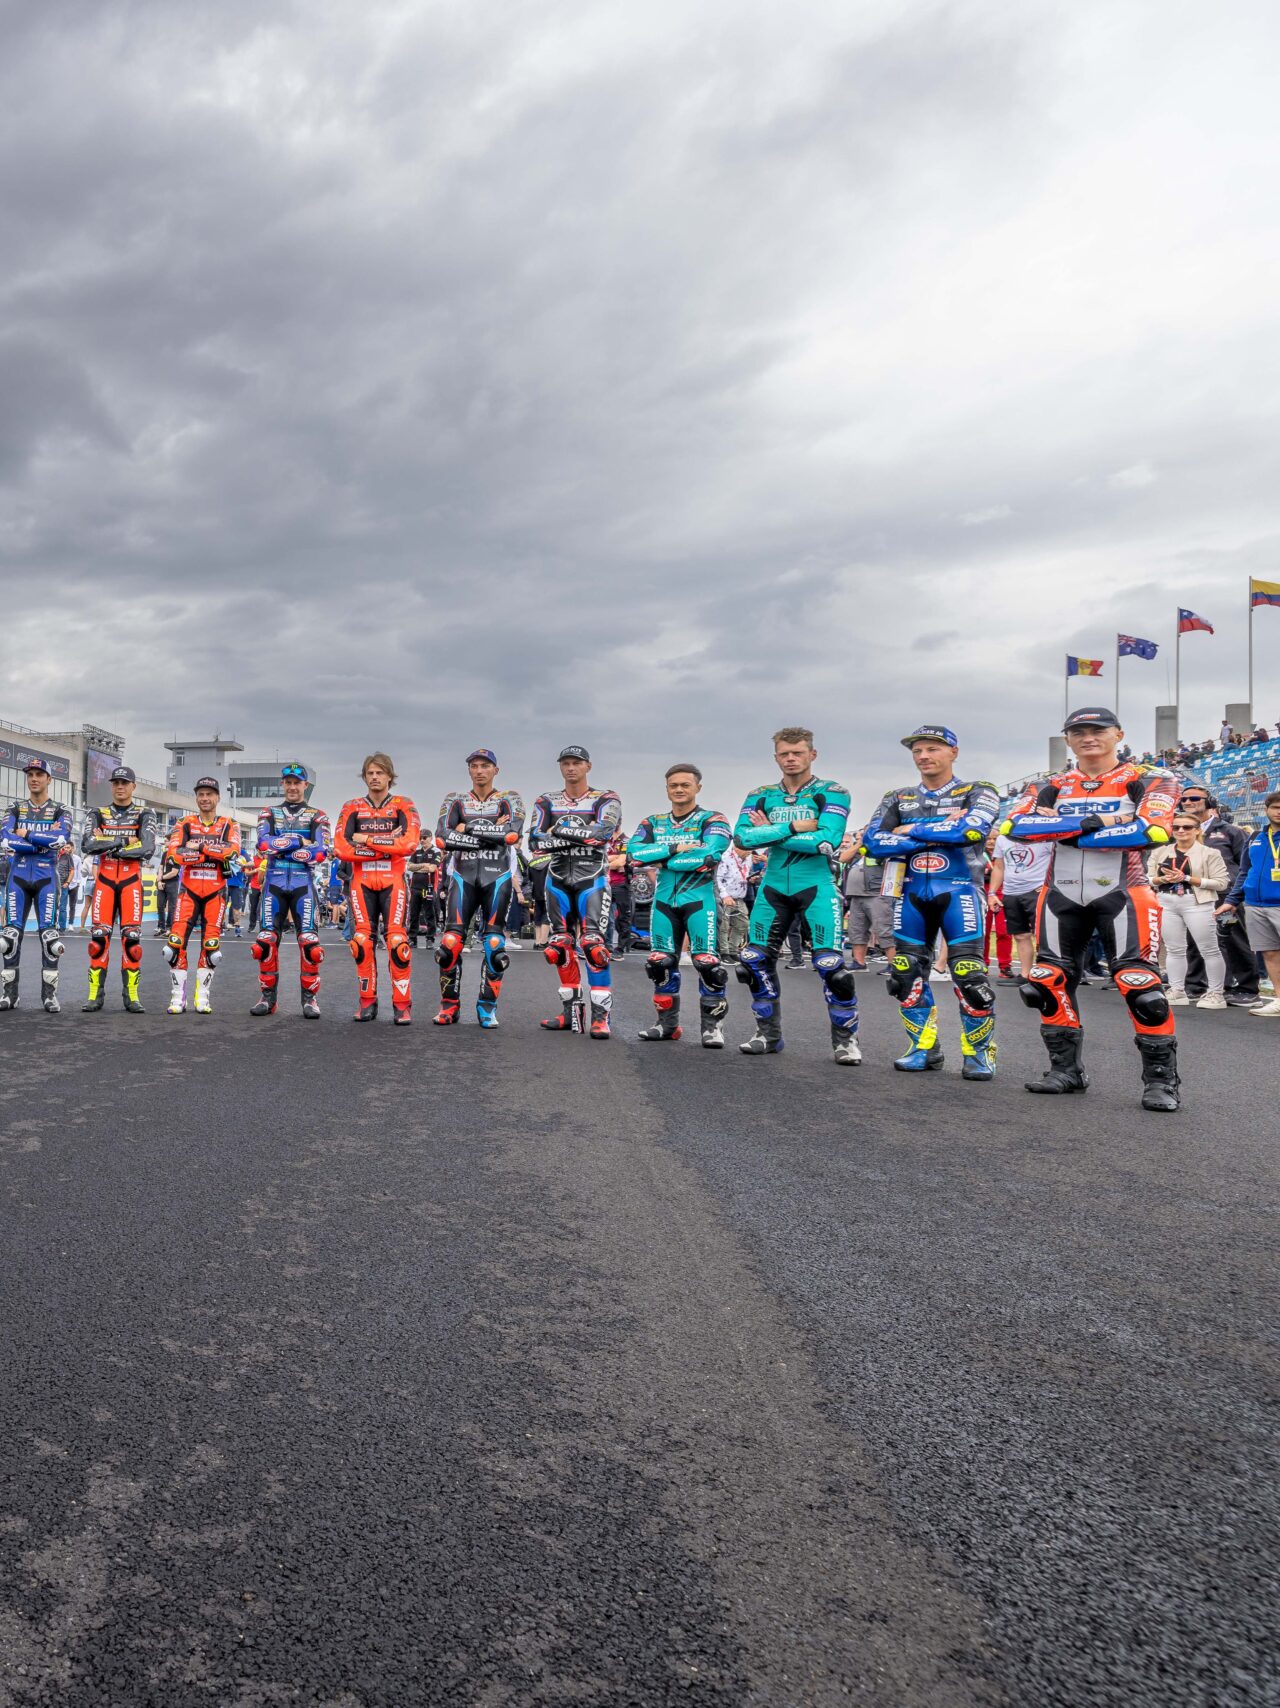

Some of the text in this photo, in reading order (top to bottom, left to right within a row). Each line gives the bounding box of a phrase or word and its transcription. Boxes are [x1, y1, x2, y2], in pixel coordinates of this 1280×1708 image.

[360, 821, 394, 830] aruba.it
[770, 811, 811, 822] SPRINTA
[560, 828, 593, 838] ROKiT
[461, 850, 500, 861] ROKiT
[9, 891, 17, 922] YAMAHA
[44, 892, 54, 923] YAMAHA
[93, 889, 103, 922] DUCATI
[215, 902, 226, 928] DUCATI
[263, 896, 273, 927] YAMAHA
[302, 898, 312, 928] YAMAHA
[351, 889, 365, 923] DUCATI
[393, 889, 405, 925] DUCATI
[963, 894, 977, 933] YAMAHA
[707, 910, 715, 954] PETRONAS
[832, 897, 841, 950] PETRONAS
[1147, 908, 1161, 963] DUCATI
[1058, 990, 1076, 1022] IXON
[968, 1017, 994, 1043] daytona
